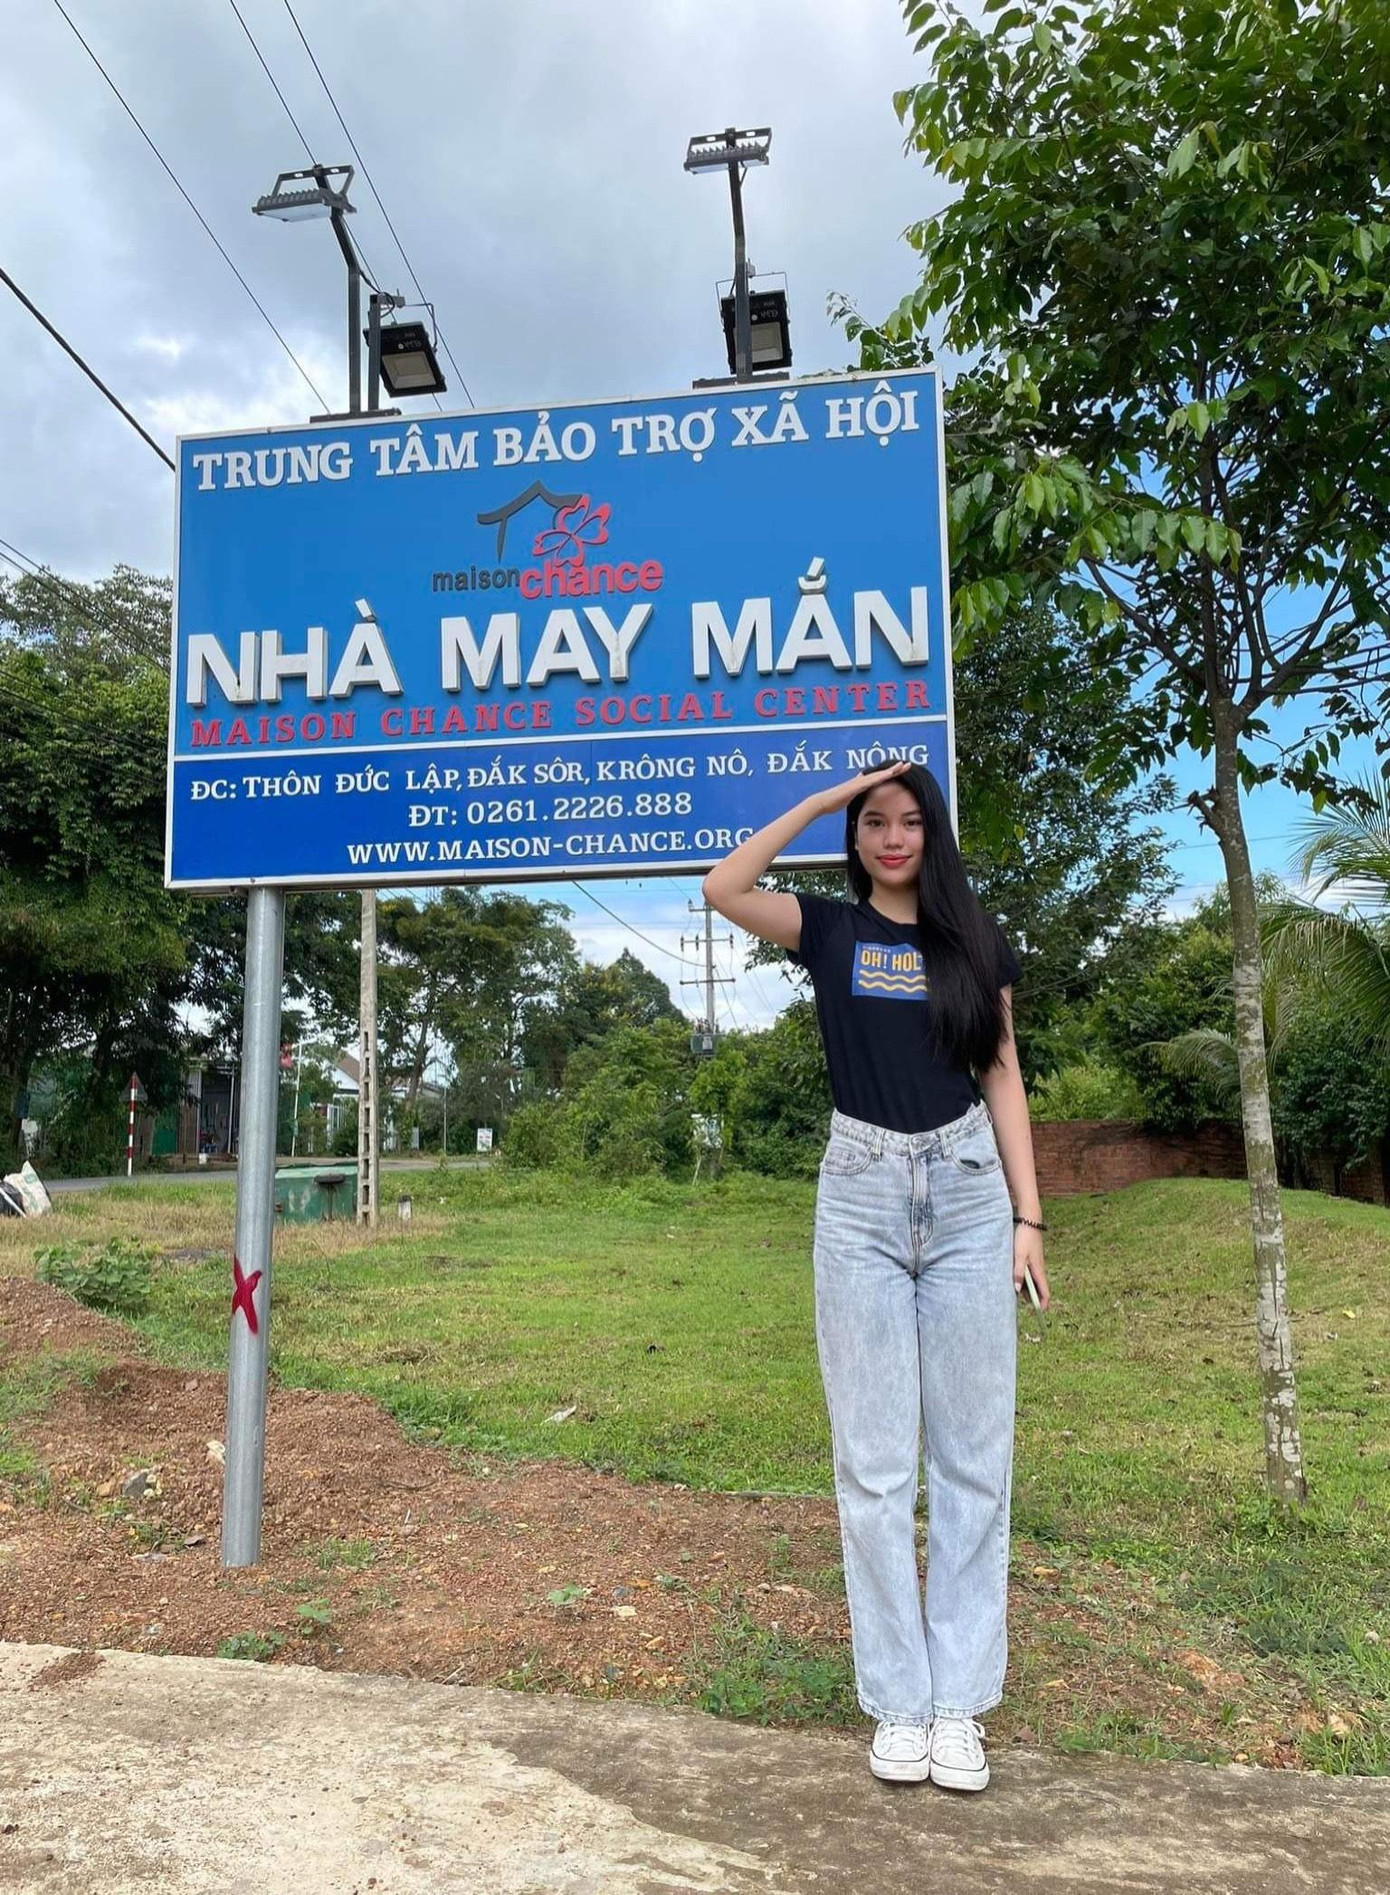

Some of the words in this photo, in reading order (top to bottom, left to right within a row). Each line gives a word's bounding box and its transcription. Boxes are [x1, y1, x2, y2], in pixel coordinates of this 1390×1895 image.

[193, 441, 353, 491] TRUNG
[370, 423, 479, 476] TÂM
[493, 410, 596, 466] BẢO
[611, 407, 717, 462] TRỢ
[731, 390, 809, 447] XÃ
[825, 380, 920, 447] HỘI
[186, 598, 403, 706] NHÀ
[440, 602, 653, 692] MAY
[691, 557, 930, 680] MẮN
[191, 711, 356, 748] MAISON
[380, 702, 551, 737] CHANCE
[575, 692, 732, 726] SOCIAL
[754, 681, 931, 717] CENTER
[190, 778, 237, 801] ĐC:
[242, 769, 322, 798] THÔN
[335, 764, 390, 793] ĐỨC
[533, 756, 591, 785] SÔR,
[597, 753, 696, 781] KRÔNG
[707, 747, 754, 777] NÔ,
[767, 739, 833, 774] ĐẮK
[846, 740, 929, 770] NÔNG
[408, 805, 458, 828] ĐT:
[467, 792, 692, 824] 0261.2226.888
[346, 827, 754, 865] WWW.MAISON-CHANCE.ORG
